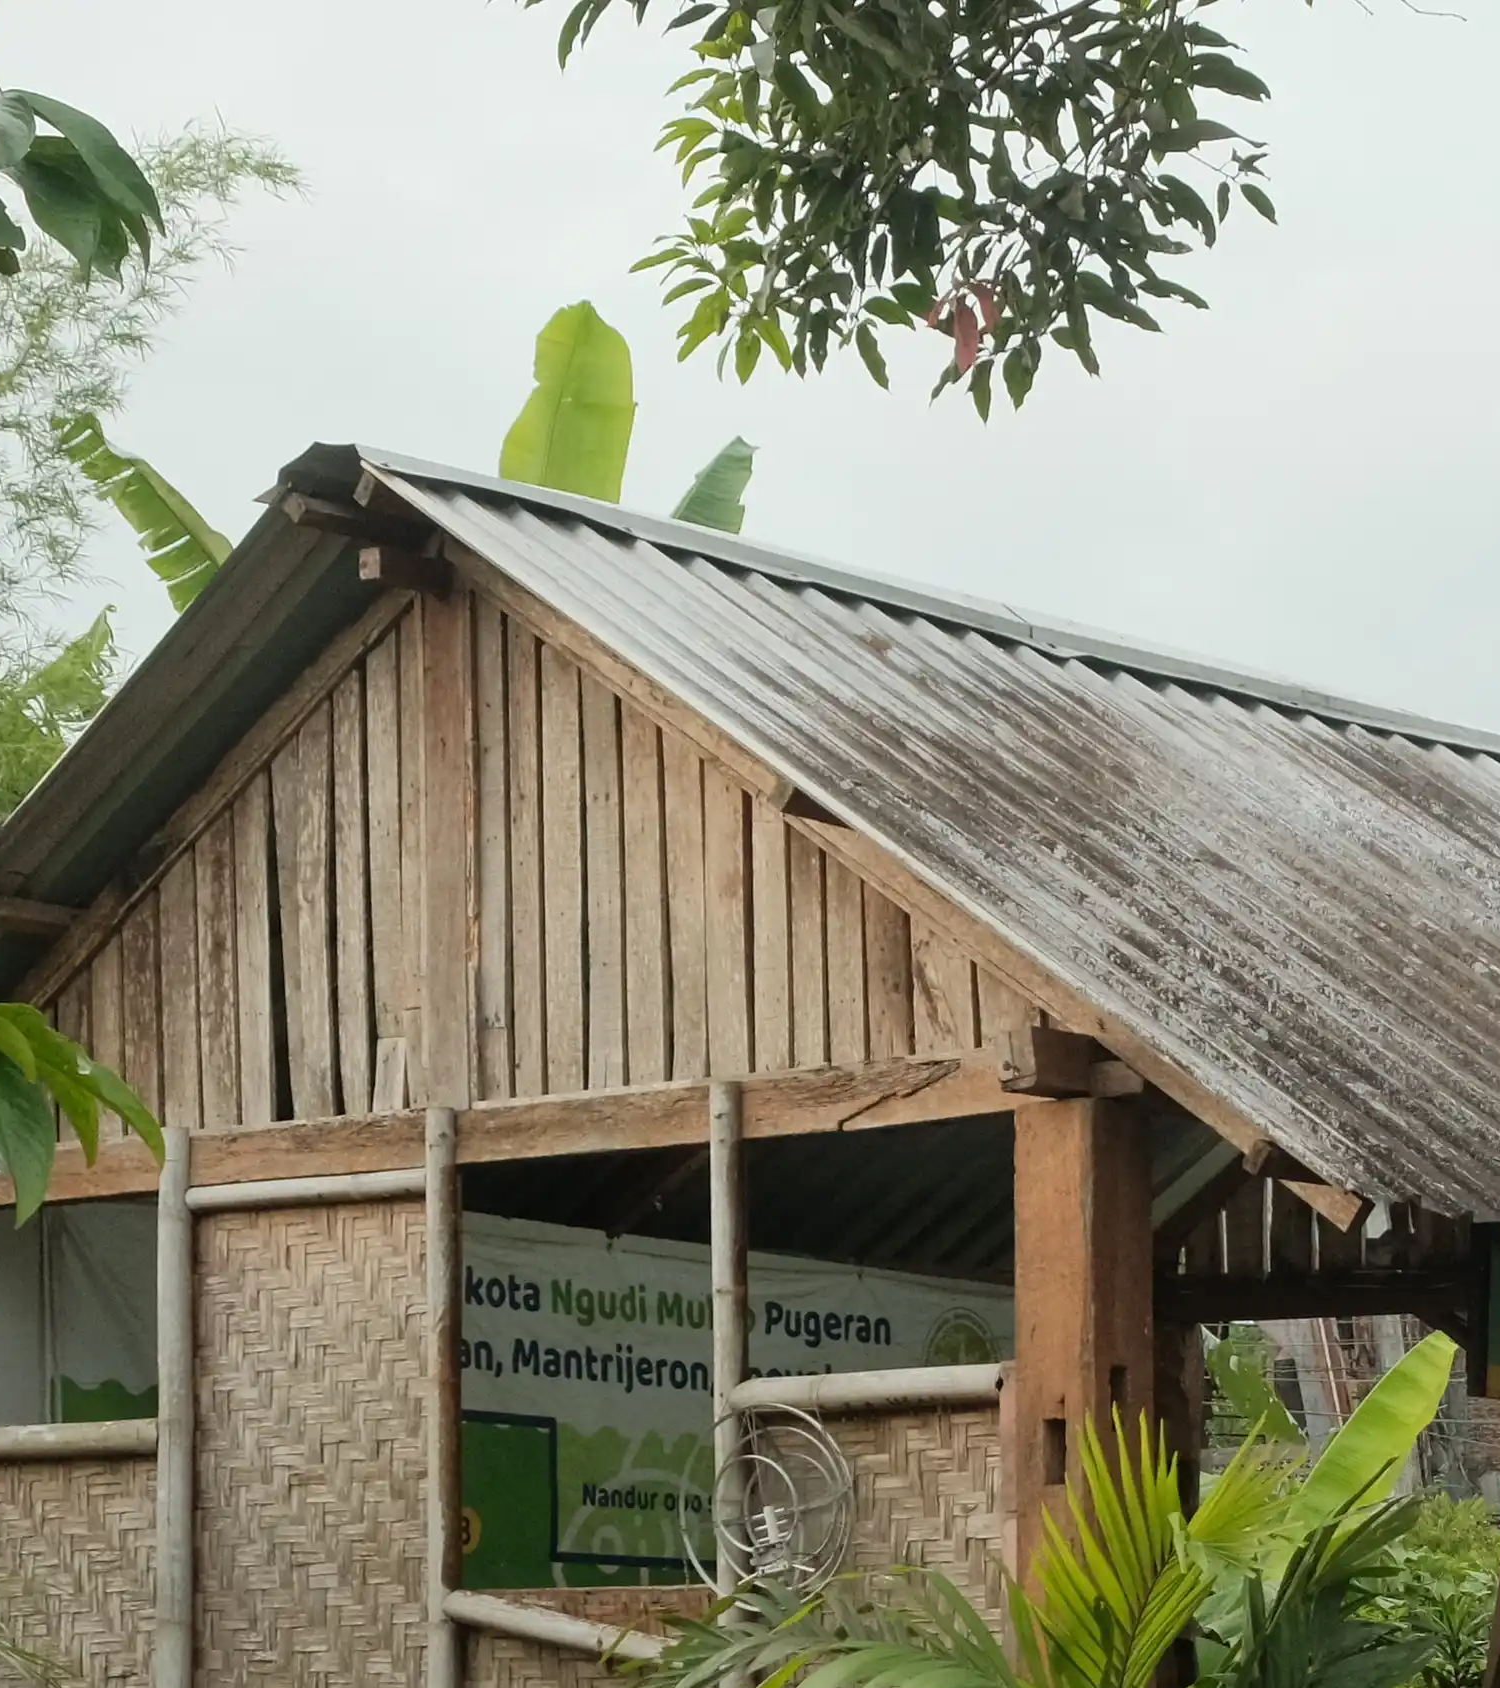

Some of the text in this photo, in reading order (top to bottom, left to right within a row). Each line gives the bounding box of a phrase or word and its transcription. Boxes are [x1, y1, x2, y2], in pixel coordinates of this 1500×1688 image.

[464, 1265, 541, 1312] kota
[550, 1279, 647, 1327] Ngudi
[656, 1290, 756, 1334] Mul
[764, 1301, 892, 1348] Pugeran
[582, 1483, 659, 1511] Nandur
